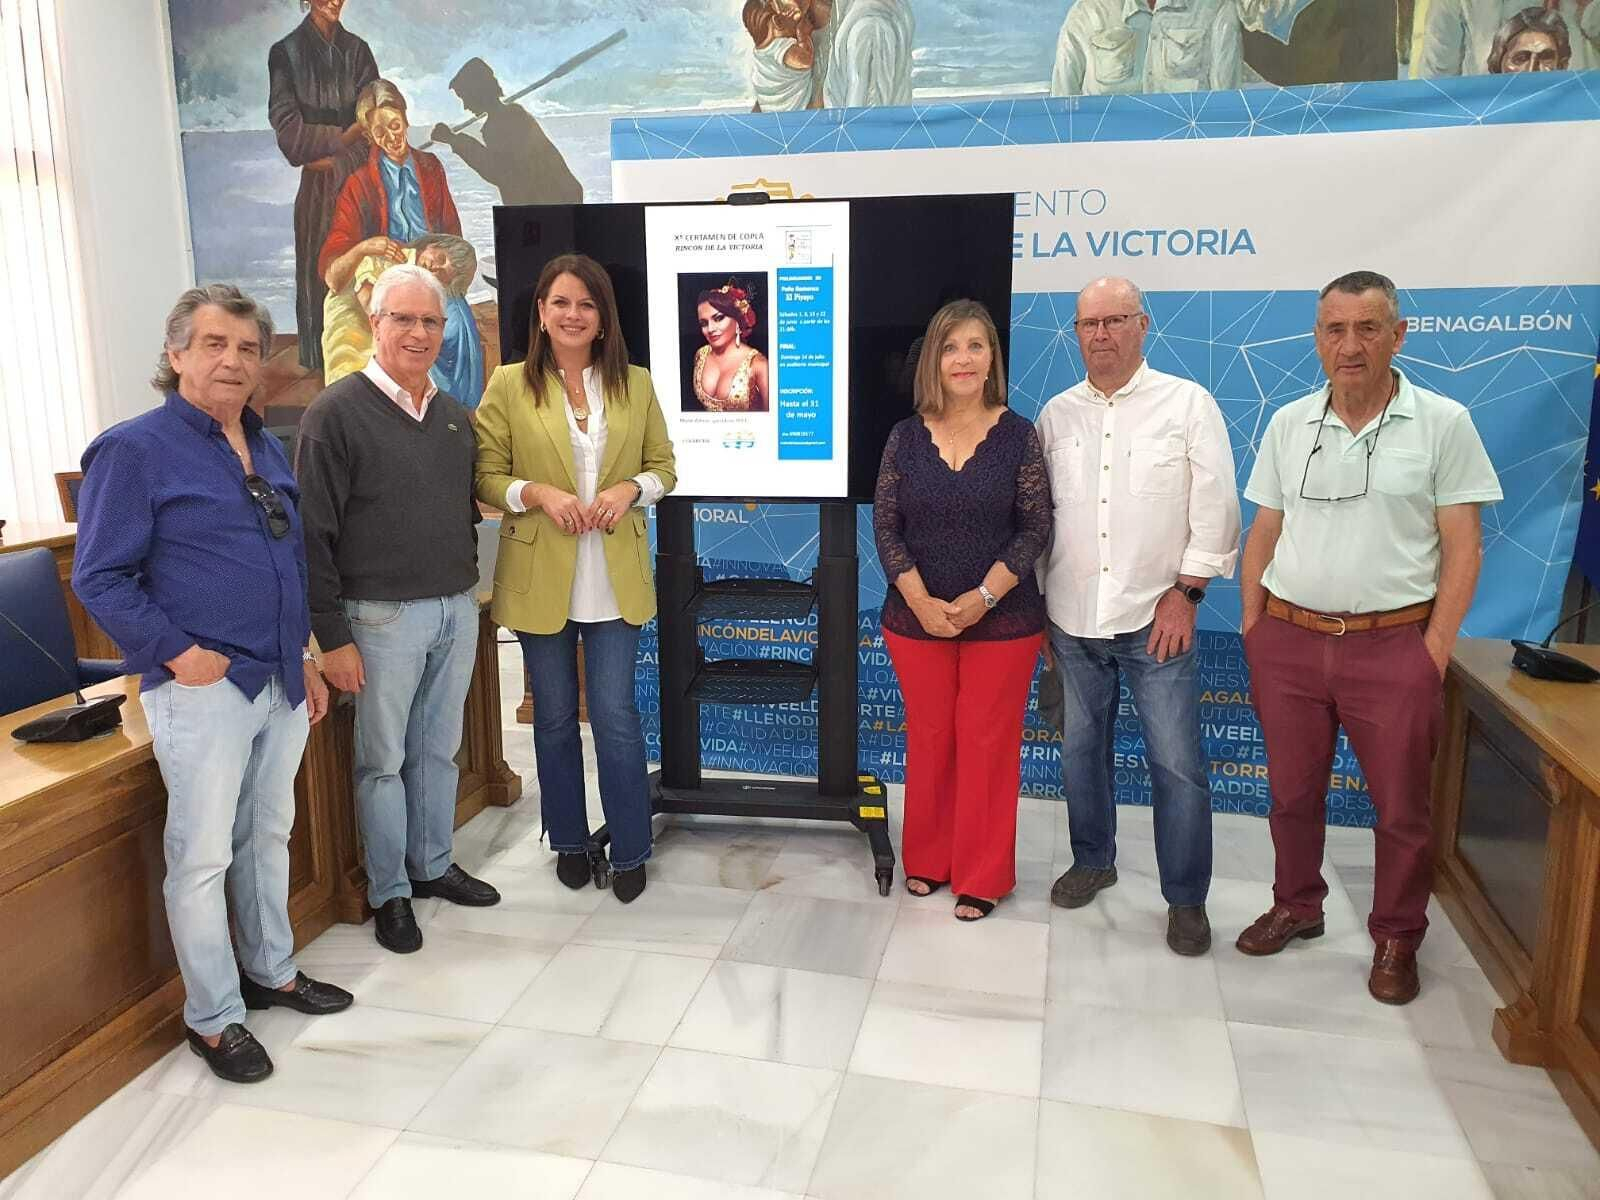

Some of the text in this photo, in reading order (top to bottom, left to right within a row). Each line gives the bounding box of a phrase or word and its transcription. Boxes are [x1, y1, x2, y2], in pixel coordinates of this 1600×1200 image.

[685, 233, 726, 241] CERTAMEN
[727, 233, 736, 241] DE
[739, 232, 764, 241] COPLA
[729, 243, 764, 251] VICTORIA
[1033, 231, 1077, 258] LA
[1086, 229, 1257, 257] VICTORIA
[1406, 309, 1573, 333] BENAGALBÓN
[780, 399, 800, 408] Hasta
[801, 399, 809, 408] el
[796, 412, 817, 420] mayo
[1209, 779, 1269, 799] ADDE
